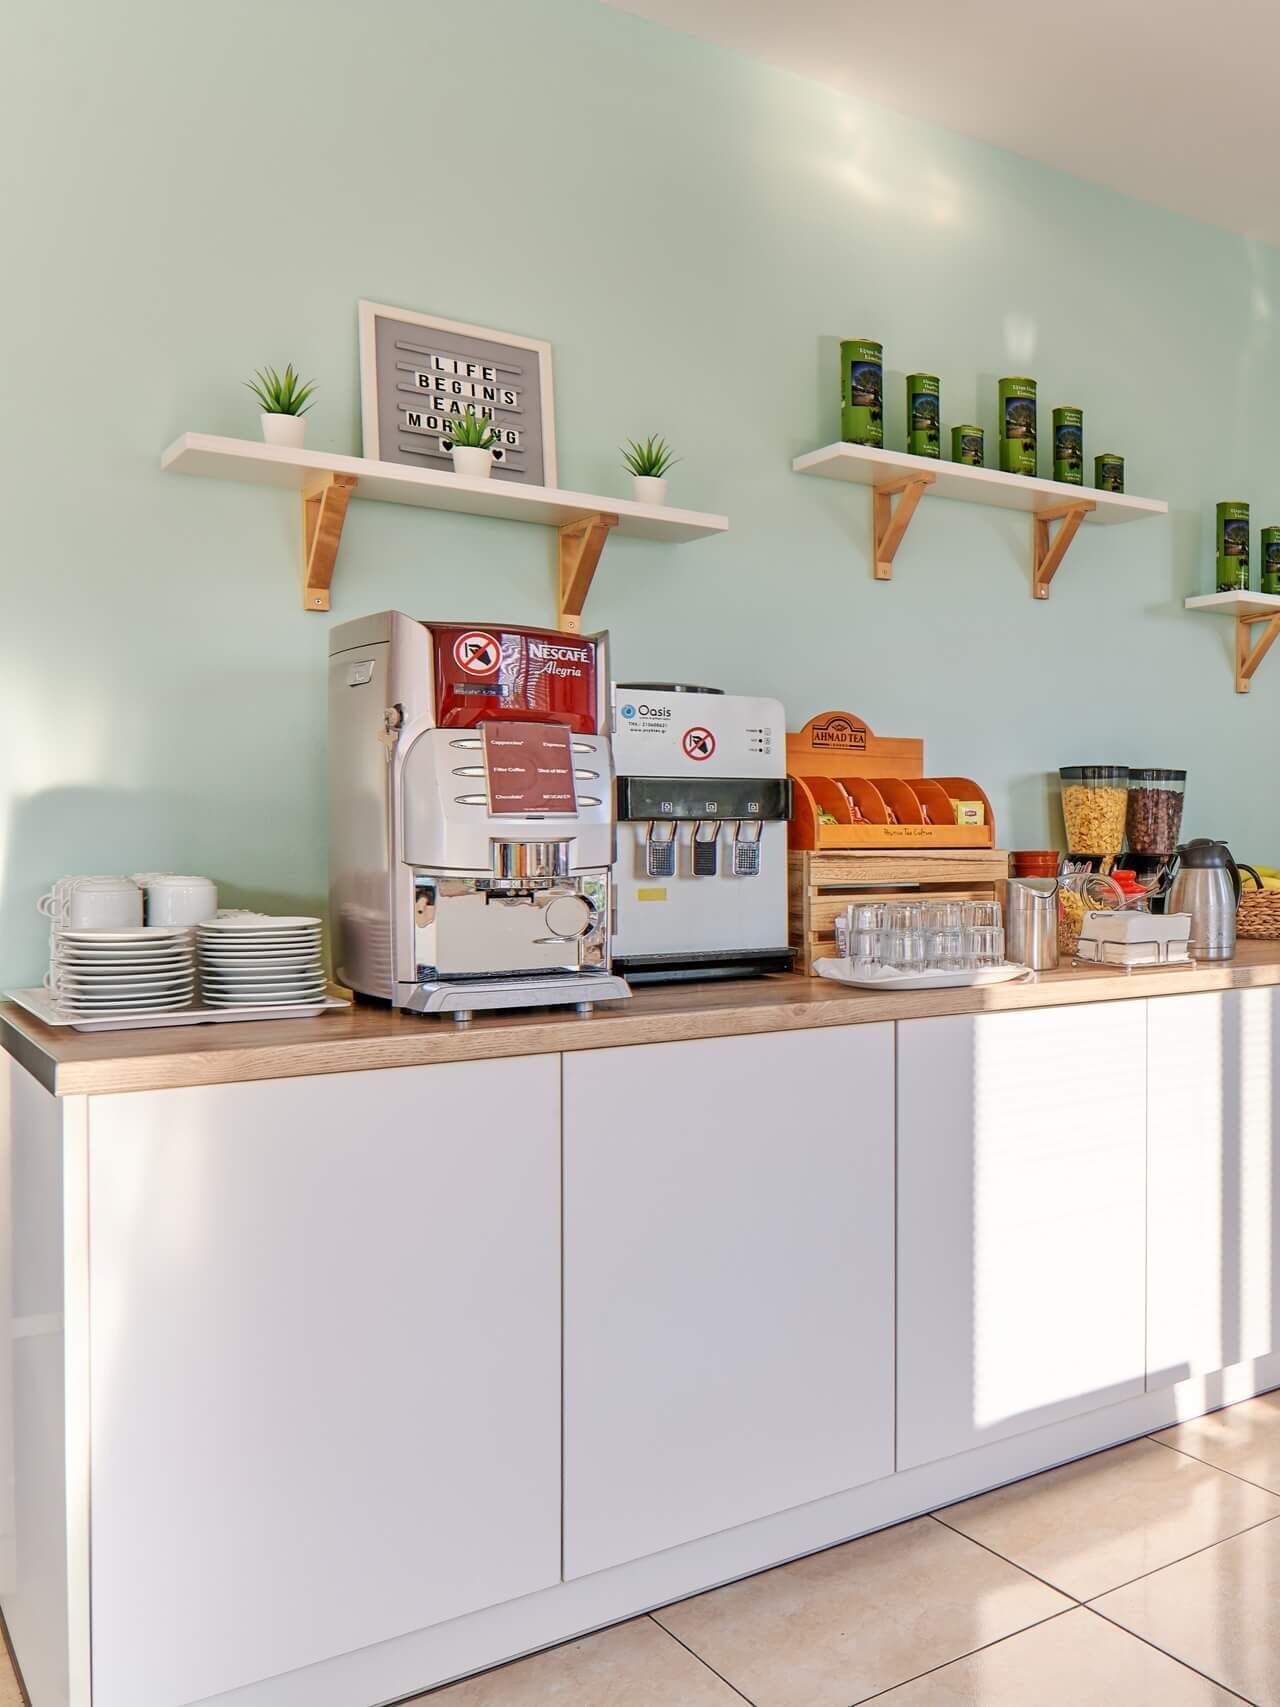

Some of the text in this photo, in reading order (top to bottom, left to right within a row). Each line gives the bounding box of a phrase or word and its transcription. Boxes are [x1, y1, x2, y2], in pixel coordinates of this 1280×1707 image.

[434, 357, 494, 382] LIFE
[418, 374, 514, 405] BEGINS
[433, 397, 493, 420] EACH
[408, 413, 516, 444] MORNG
[528, 644, 591, 664] NESCAFÉ
[534, 661, 582, 679] Alegria
[638, 704, 672, 718] Oasis
[814, 731, 865, 744] AHMAD TEA
